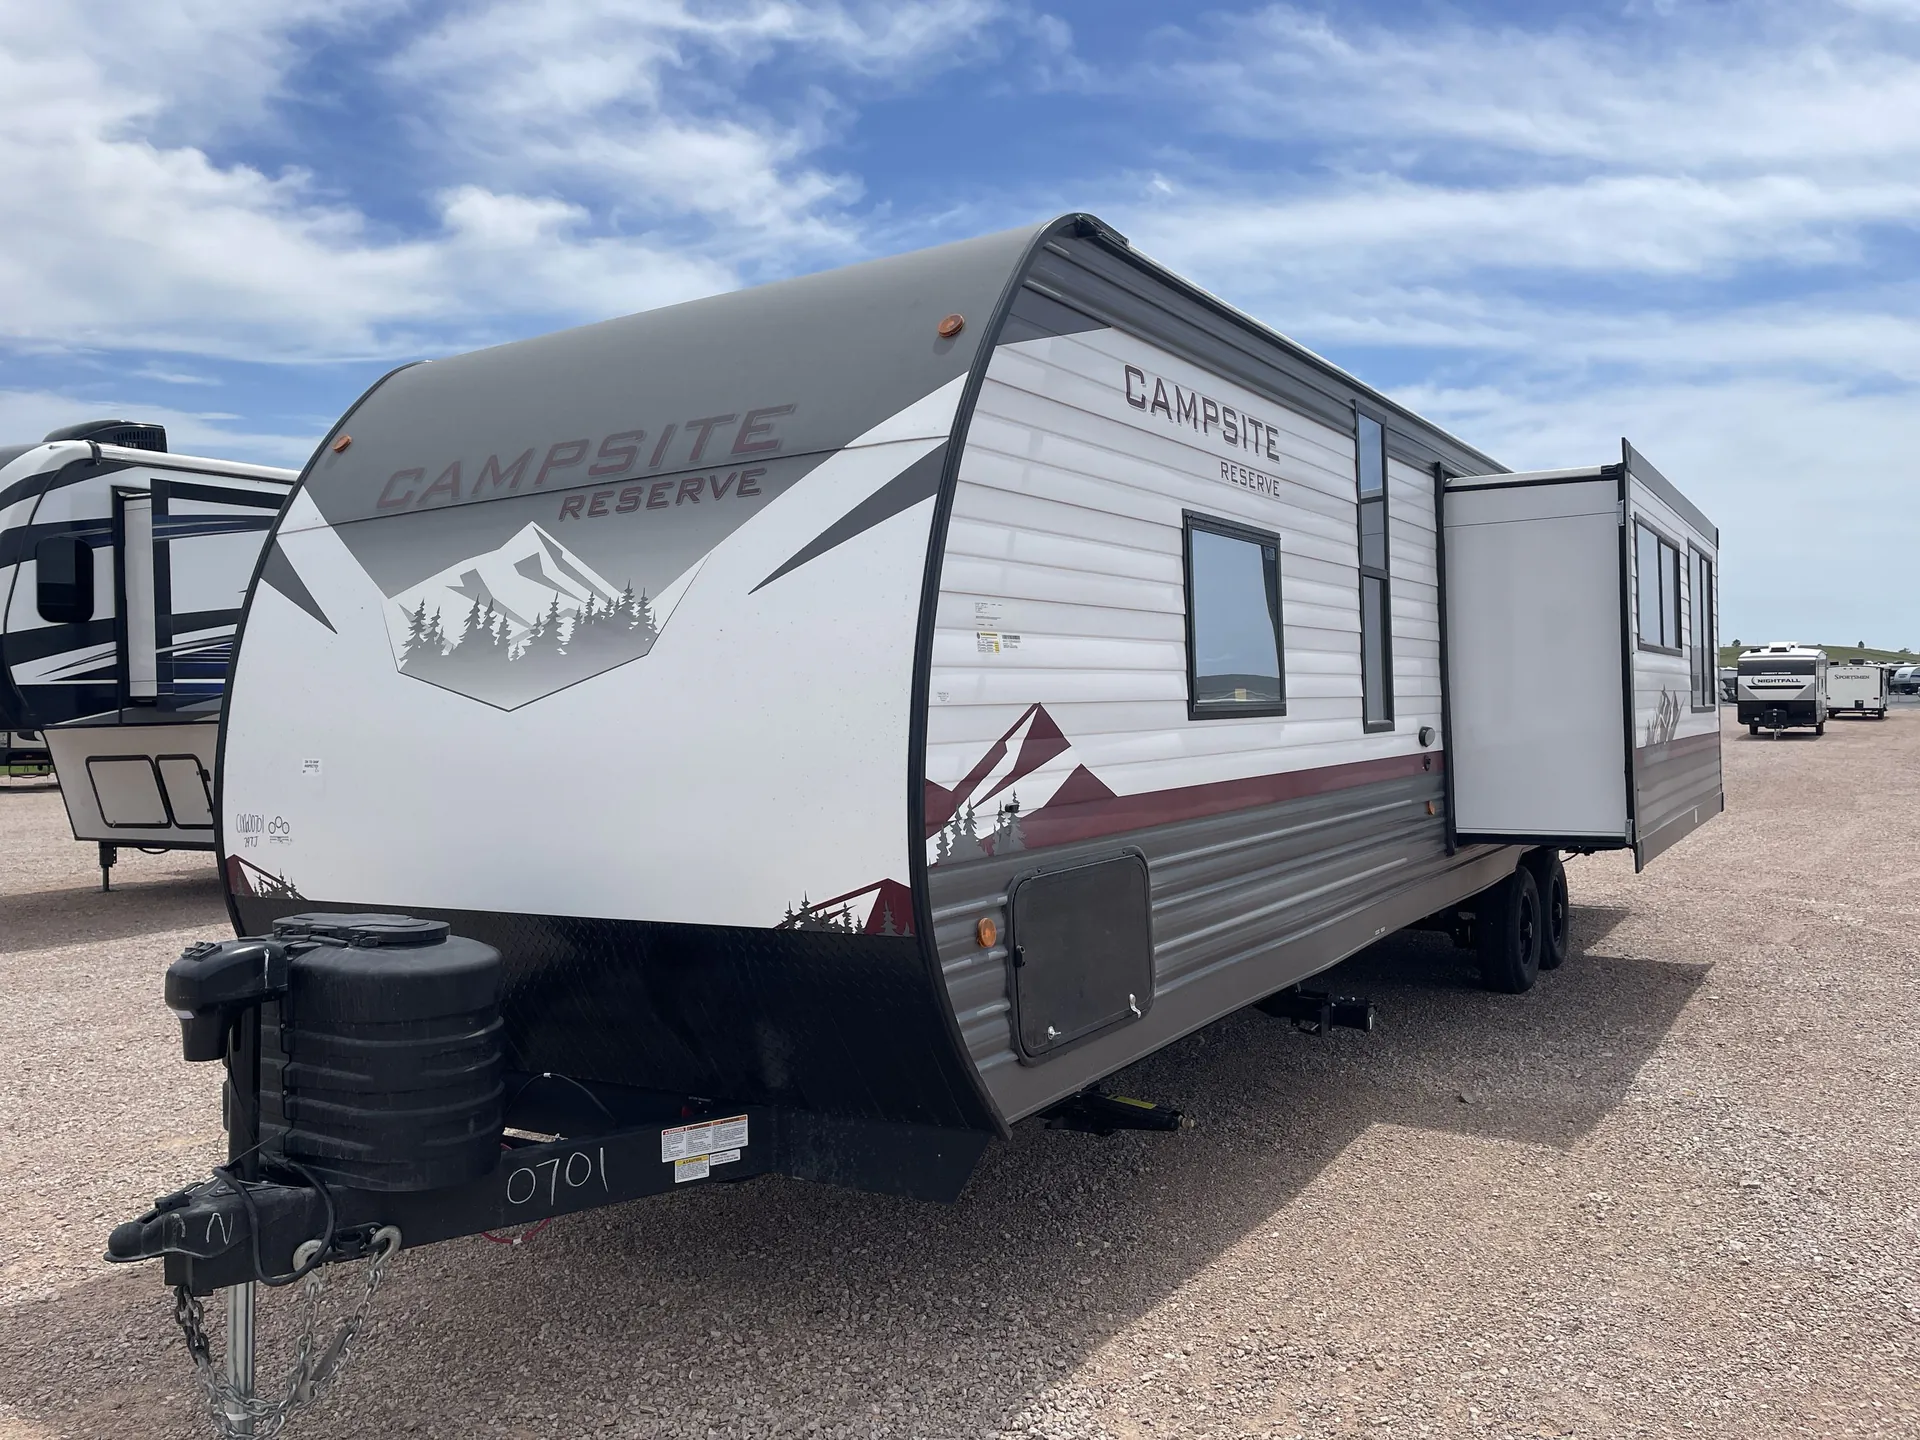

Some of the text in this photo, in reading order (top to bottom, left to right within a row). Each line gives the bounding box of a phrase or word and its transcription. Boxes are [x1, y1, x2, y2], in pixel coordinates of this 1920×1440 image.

[1125, 364, 1280, 464] CAMPSITE
[376, 403, 796, 511] CAMPSITE
[1220, 461, 1280, 498] RESERVE
[558, 467, 768, 522] RESERVE
[507, 1147, 608, 1206] 0701
